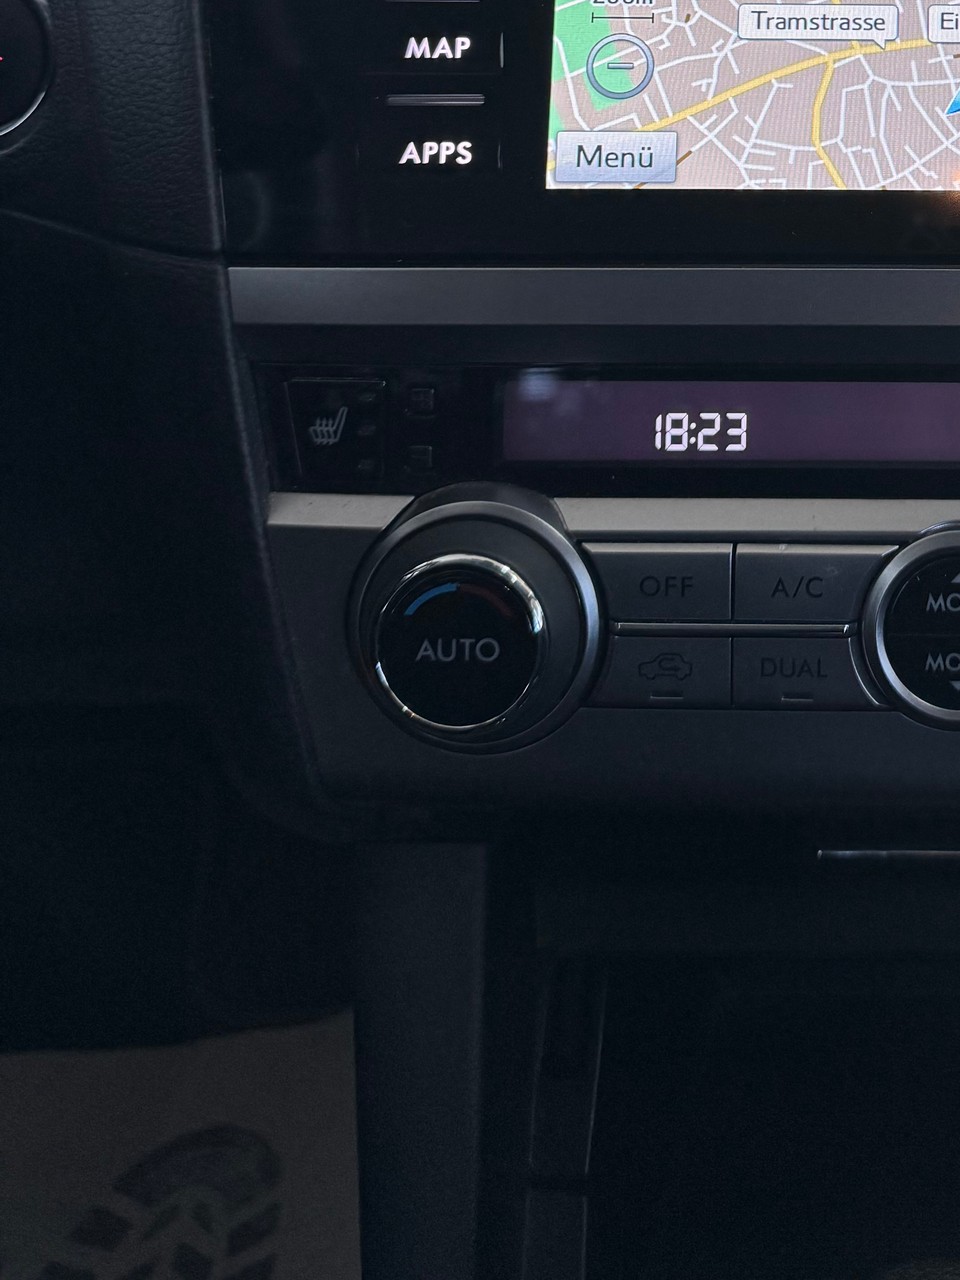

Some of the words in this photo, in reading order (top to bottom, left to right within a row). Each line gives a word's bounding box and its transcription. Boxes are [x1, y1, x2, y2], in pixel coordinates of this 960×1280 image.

[751, 11, 886, 31] Tramstrasse
[404, 37, 471, 59] MAP
[399, 142, 473, 164] APPS
[576, 145, 654, 168] Menü
[654, 412, 747, 451] 18:23
[639, 576, 694, 598] OFF
[772, 575, 824, 600] A/C
[415, 638, 500, 663] AUTO
[760, 658, 828, 679] DUAL
